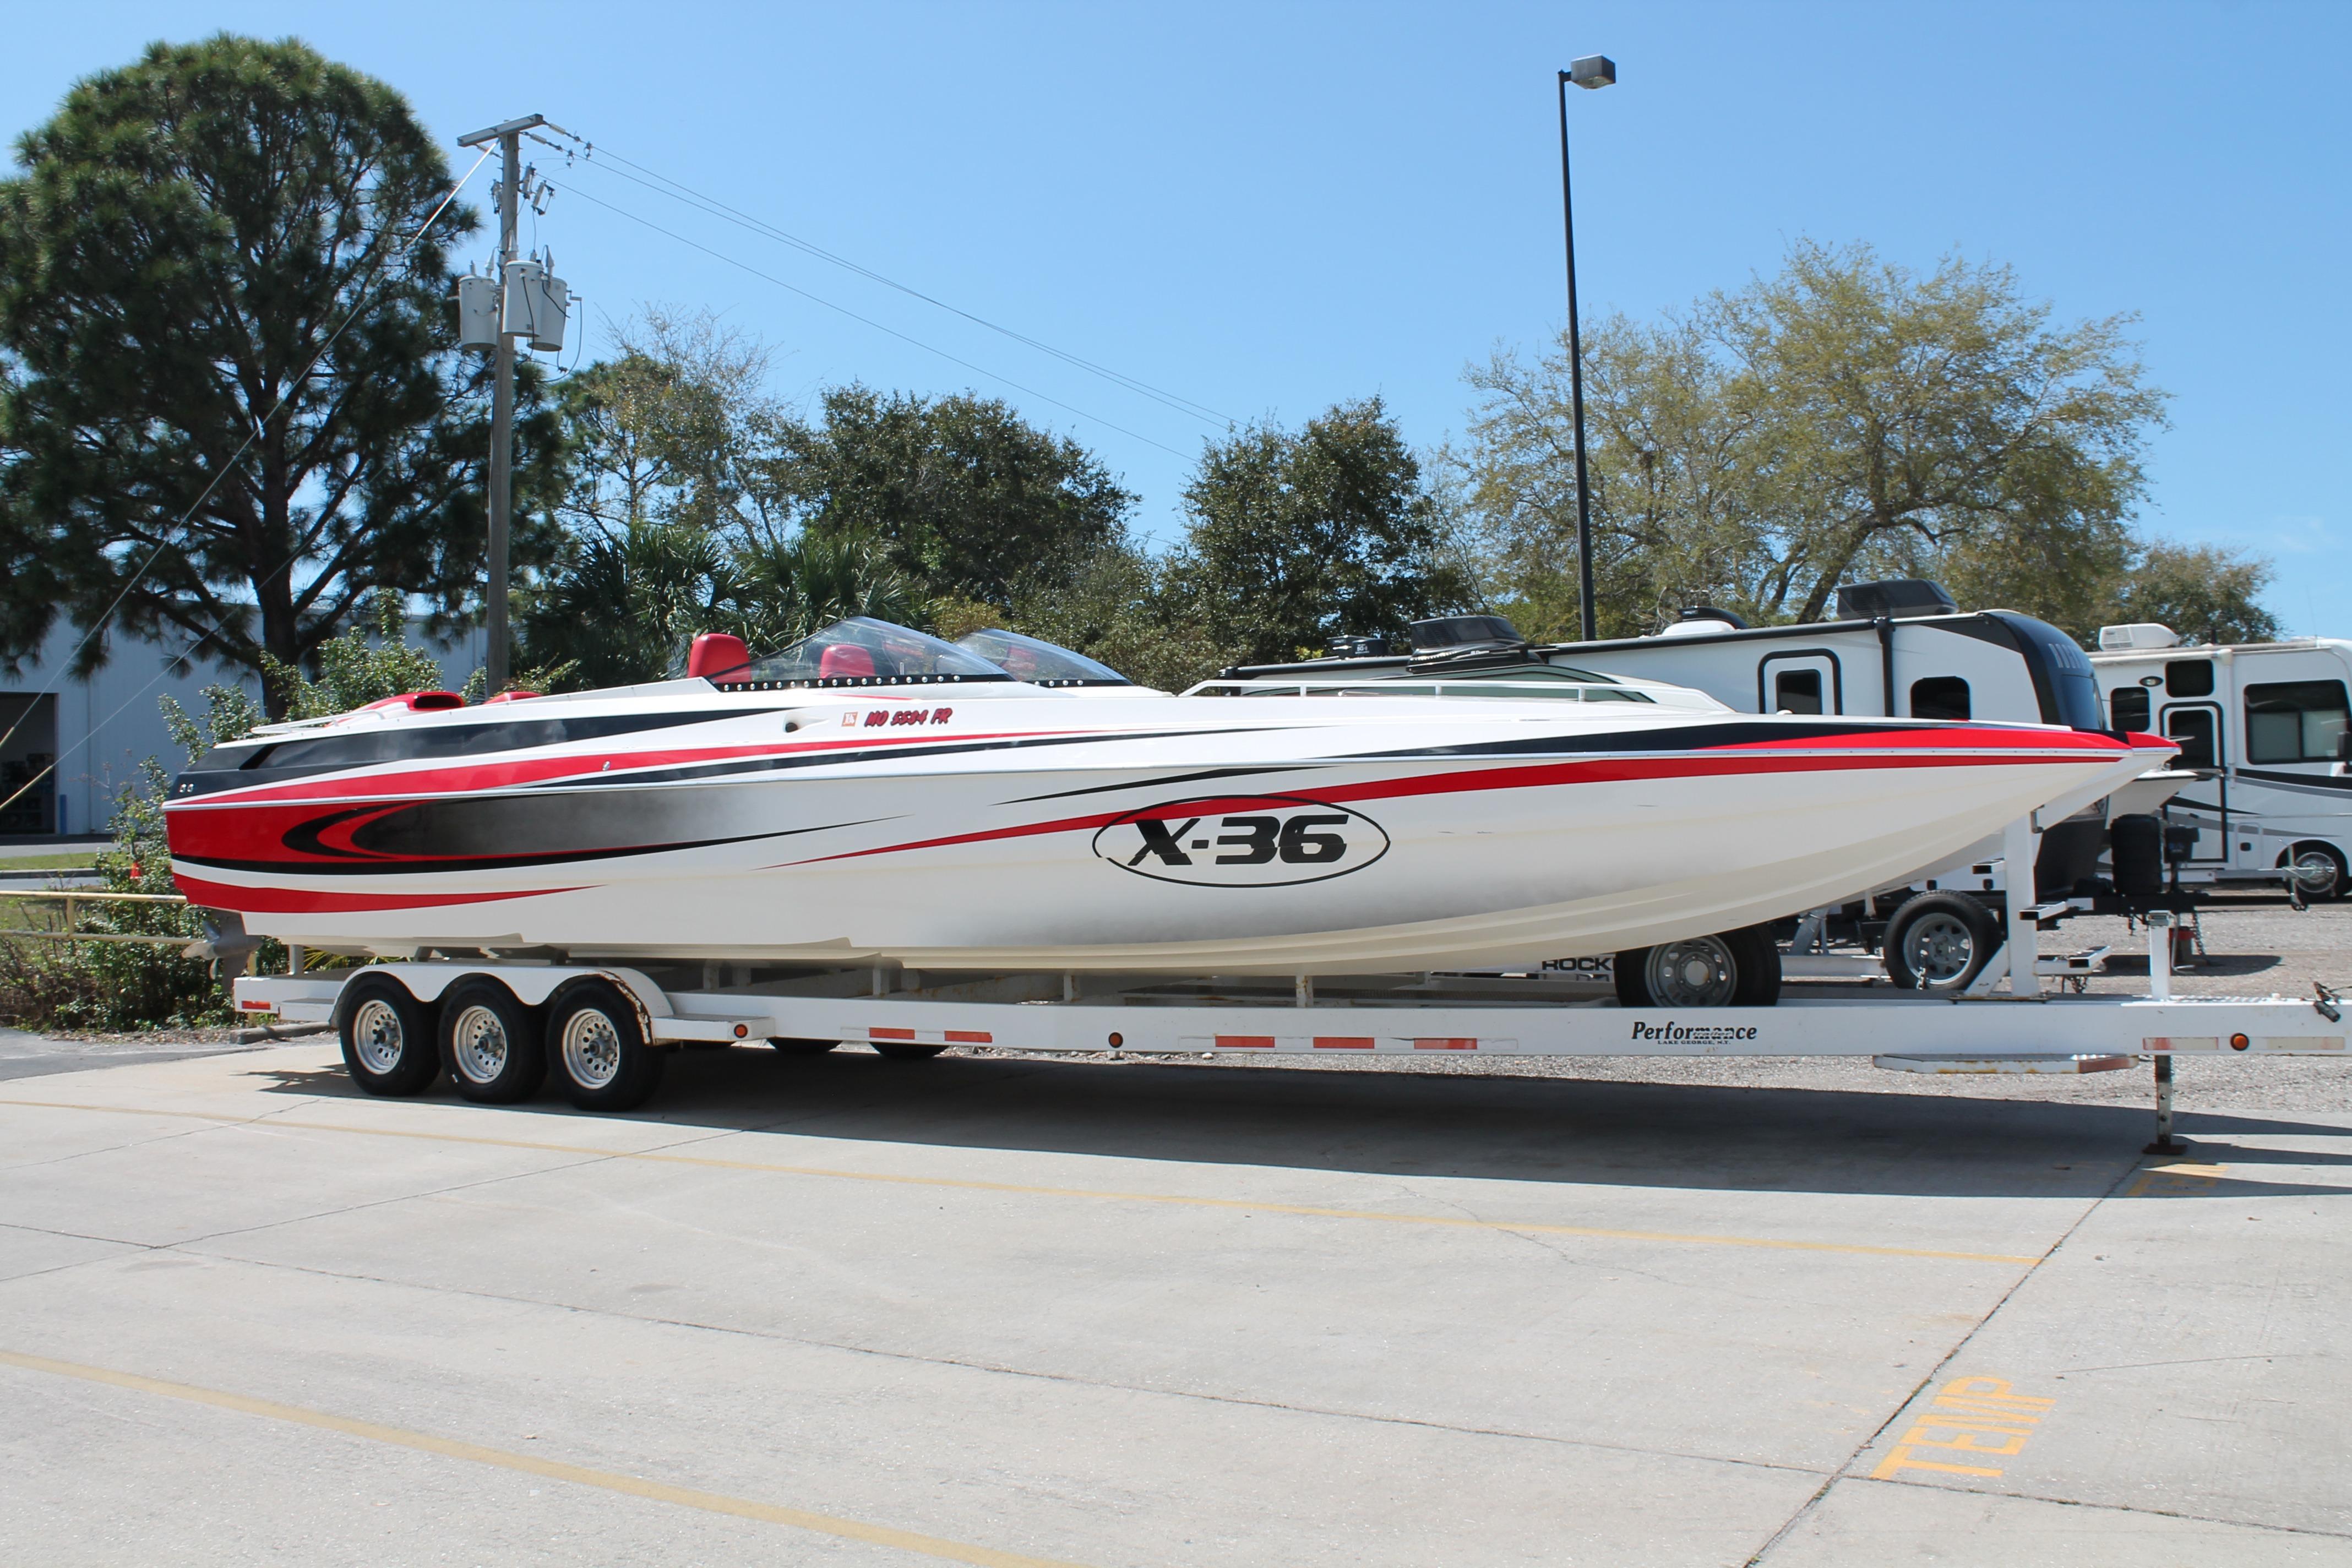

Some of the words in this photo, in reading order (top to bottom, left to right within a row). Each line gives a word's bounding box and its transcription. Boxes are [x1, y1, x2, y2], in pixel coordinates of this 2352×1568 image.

[1127, 814, 1349, 866] X-36
[1631, 1021, 1757, 1039] Performance
[1870, 1376, 2057, 1480] TEMP
